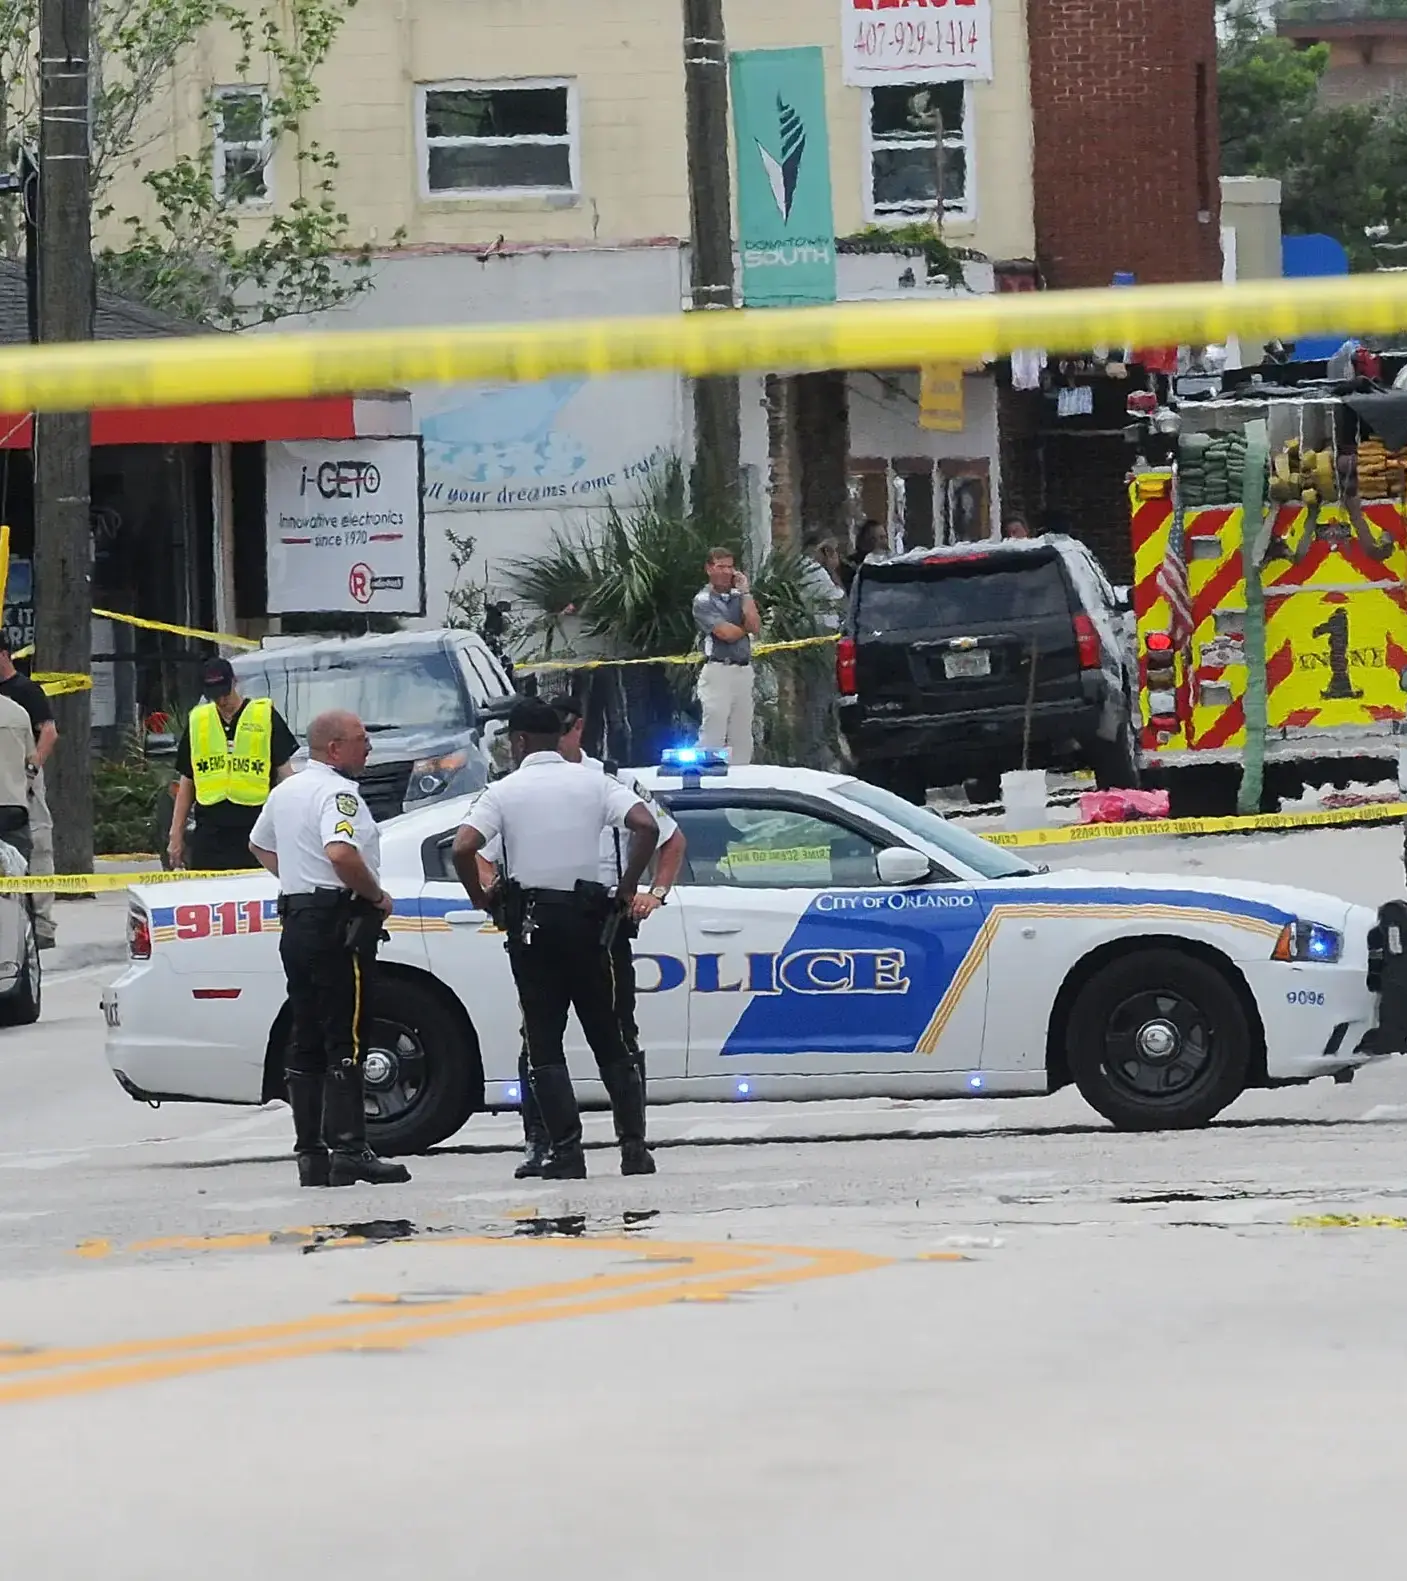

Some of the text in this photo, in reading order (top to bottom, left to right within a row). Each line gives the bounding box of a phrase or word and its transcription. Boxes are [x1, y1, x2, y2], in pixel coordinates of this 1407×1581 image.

[854, 20, 978, 55] 407-929-1414
[744, 236, 829, 250] DOWNTOWN
[744, 247, 830, 268] SOUTH
[447, 484, 490, 505] your
[497, 479, 568, 504] dreams
[571, 472, 618, 495] come
[341, 510, 404, 527] electronics
[315, 530, 368, 548] since 1970
[1312, 607, 1364, 699] 1
[209, 755, 226, 771] EMS
[232, 757, 250, 773] EMS
[815, 893, 974, 912] CITY OF ORLANDO
[174, 901, 264, 941] 911
[631, 949, 911, 995] OLICE
[1286, 990, 1325, 1006] 9096
